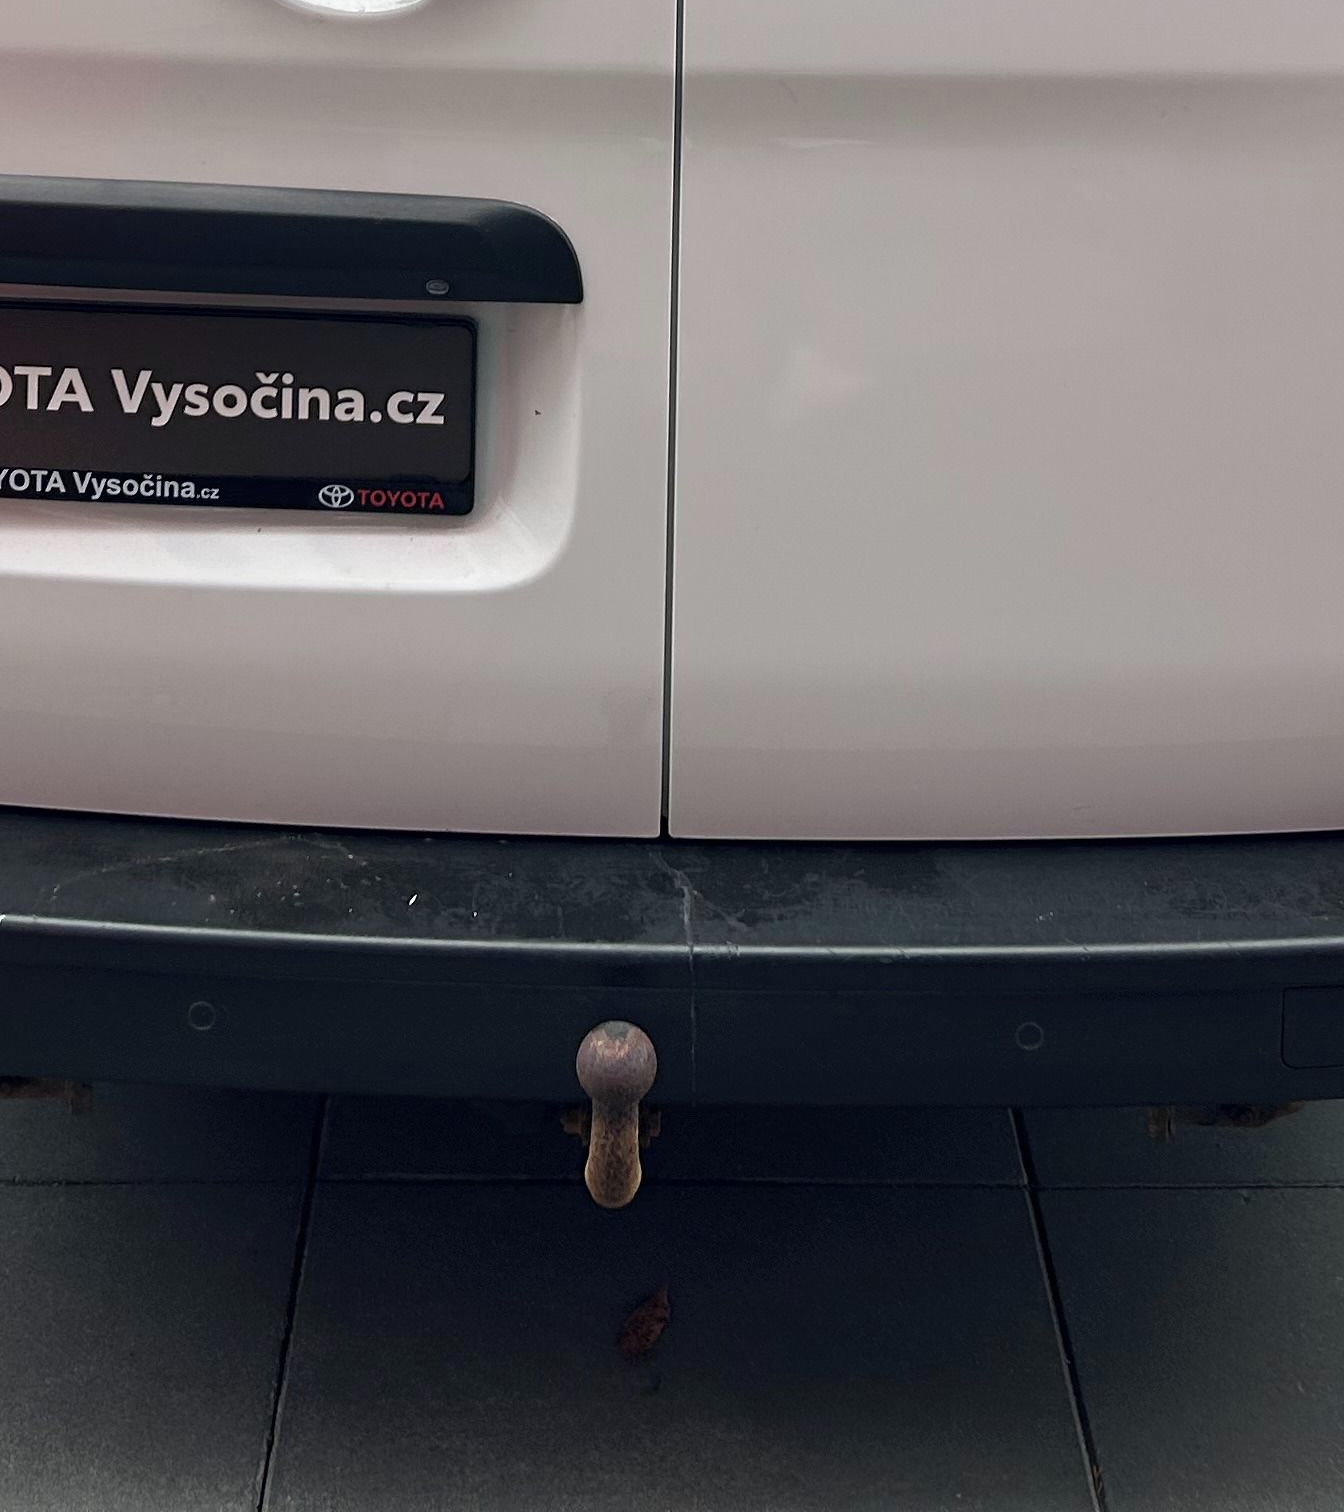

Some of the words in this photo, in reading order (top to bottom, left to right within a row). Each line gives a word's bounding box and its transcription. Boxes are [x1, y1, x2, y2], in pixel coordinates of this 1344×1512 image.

[109, 369, 445, 427] Vysočina.cz
[73, 472, 220, 500] Vysočina.cz
[357, 489, 445, 509] TOYOTA
